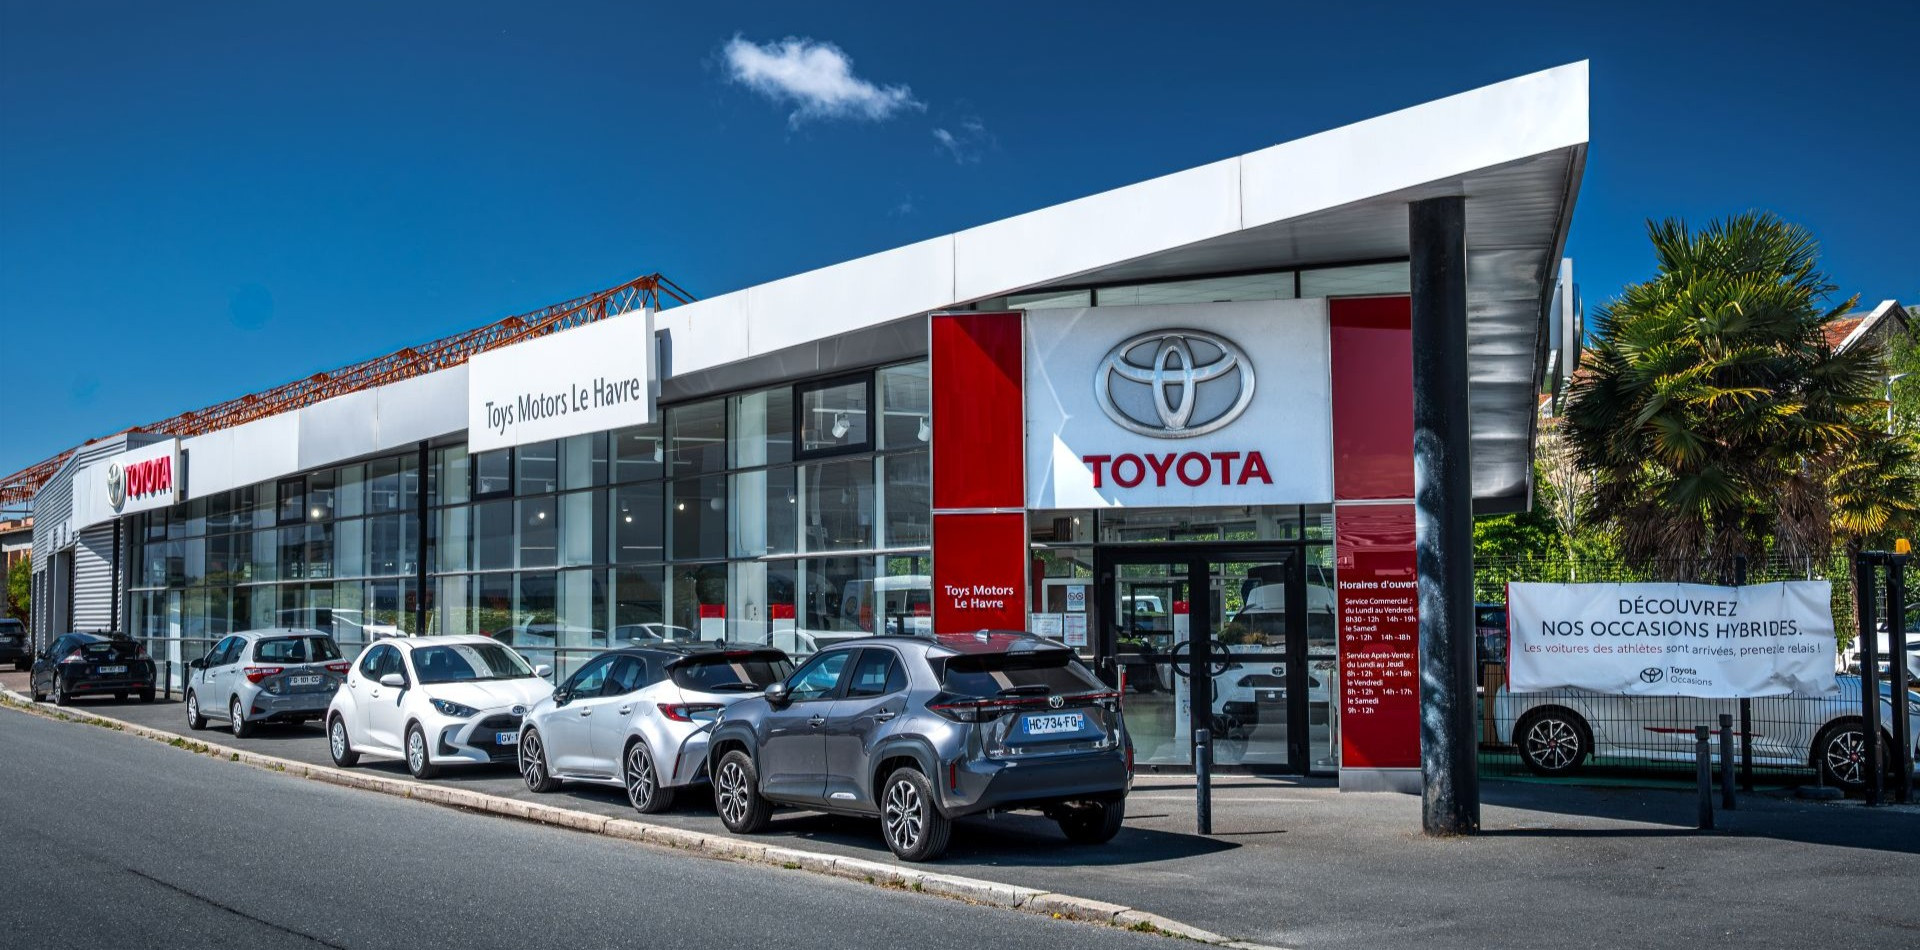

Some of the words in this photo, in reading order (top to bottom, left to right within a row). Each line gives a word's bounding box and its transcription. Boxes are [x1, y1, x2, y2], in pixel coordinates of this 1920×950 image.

[486, 401, 514, 436] Toys
[518, 393, 567, 423] Motors
[572, 383, 588, 412] Le
[594, 377, 640, 408] Havre
[125, 456, 172, 496] TOYOTA
[1083, 451, 1273, 488] TOYOTA
[945, 585, 970, 598] Toys
[973, 585, 1014, 596] Motors
[1339, 581, 1378, 589] Horaires
[954, 599, 967, 608] Le
[971, 599, 1003, 608] Havre
[1619, 595, 1738, 617] DÉCOUVREZ
[1542, 621, 1584, 636] NOS
[1591, 621, 1709, 638] OCCASIONS
[1717, 620, 1802, 638] HYBRIDES.
[1371, 652, 1411, 660] Après-Vente
[1524, 643, 1542, 653] Les
[1545, 644, 1589, 653] voitures
[1593, 644, 1613, 653] des
[1617, 644, 1663, 653] athlètes
[1666, 644, 1690, 653] sont
[1692, 644, 1736, 657] arrivées,
[1788, 643, 1815, 653] relais
[1670, 666, 1697, 676] Toyota
[1671, 676, 1712, 686] Occasions
[1030, 716, 1077, 730] HC-734-FQ
[501, 733, 519, 742] GV-1
